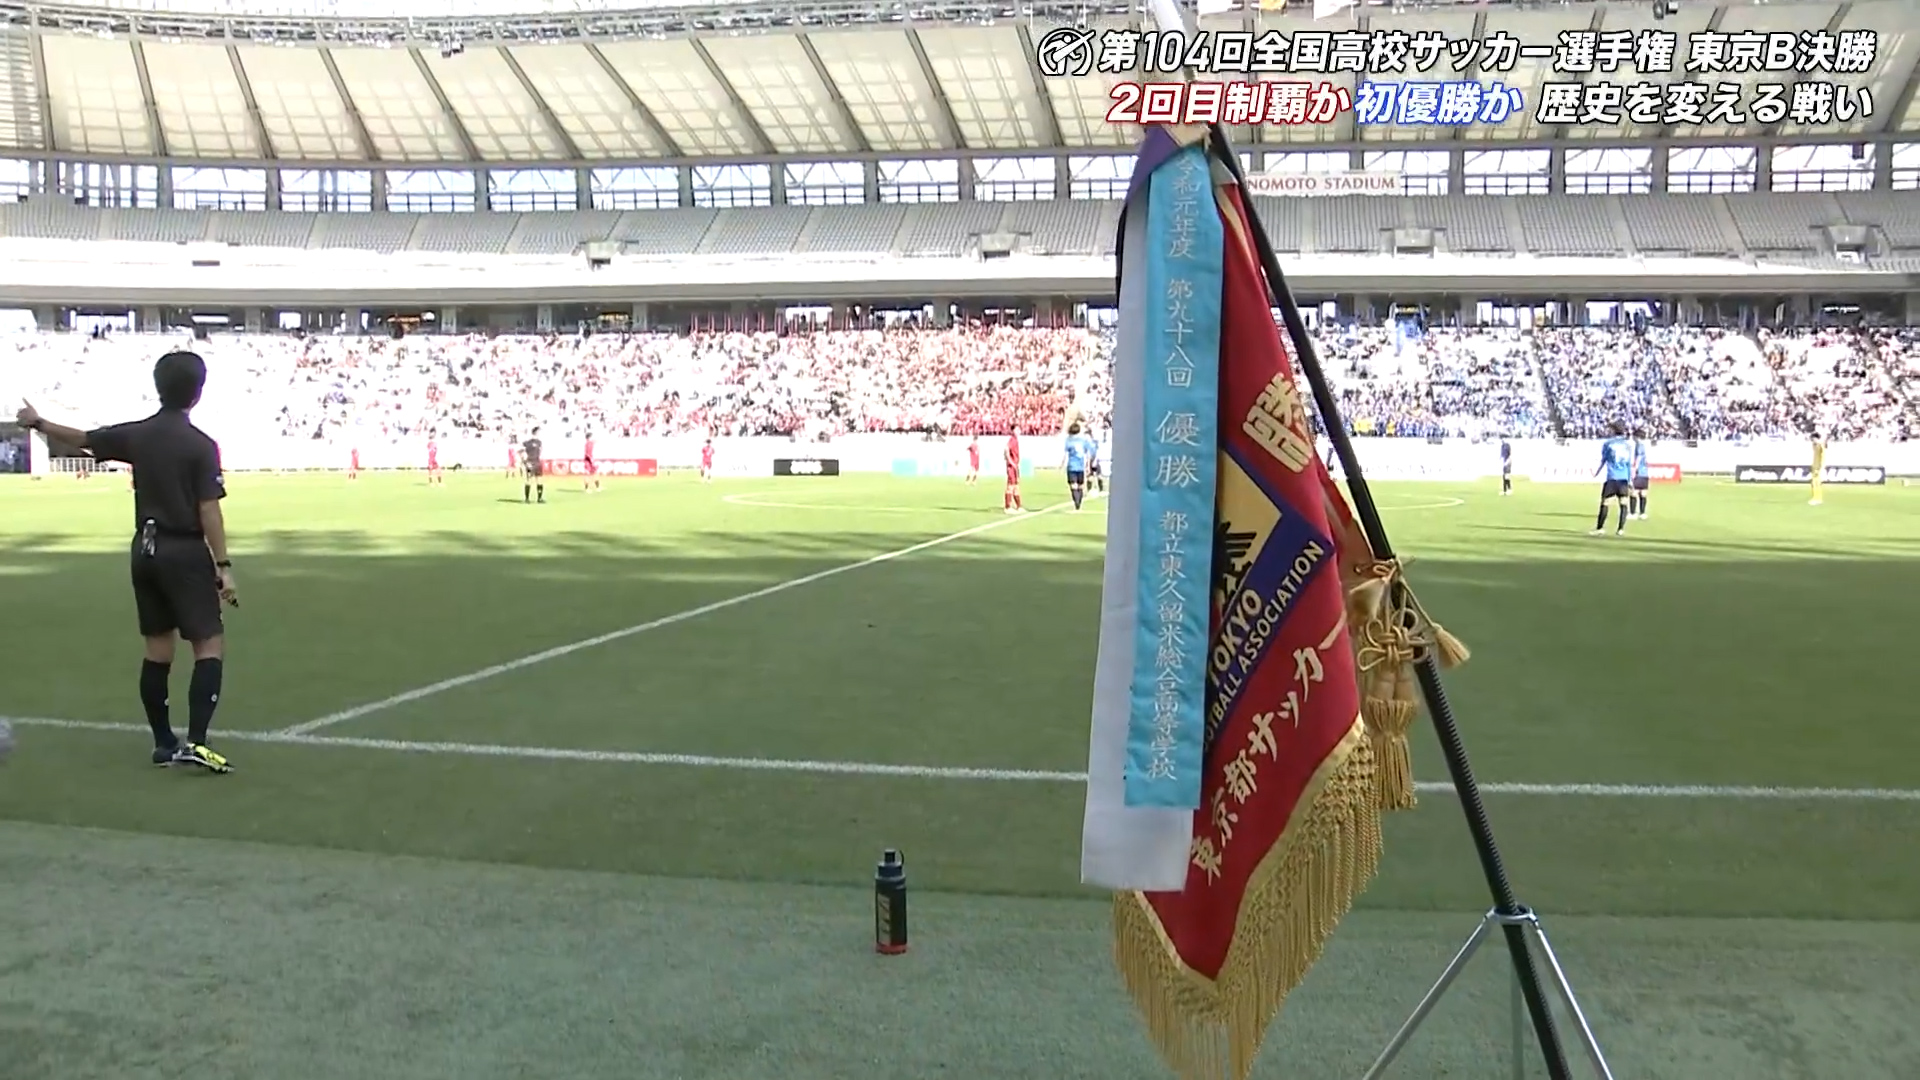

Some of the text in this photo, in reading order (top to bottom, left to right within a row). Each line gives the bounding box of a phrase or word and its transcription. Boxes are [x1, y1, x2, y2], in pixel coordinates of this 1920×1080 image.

[1324, 177, 1395, 190] STADIUM
[1147, 156, 1203, 781] 令和元年度 第九十八回 優勝 都立東久留米総合高等学校
[1203, 539, 1325, 752] OTBALL ASSOCIATION
[1208, 589, 1263, 687] TOKYO
